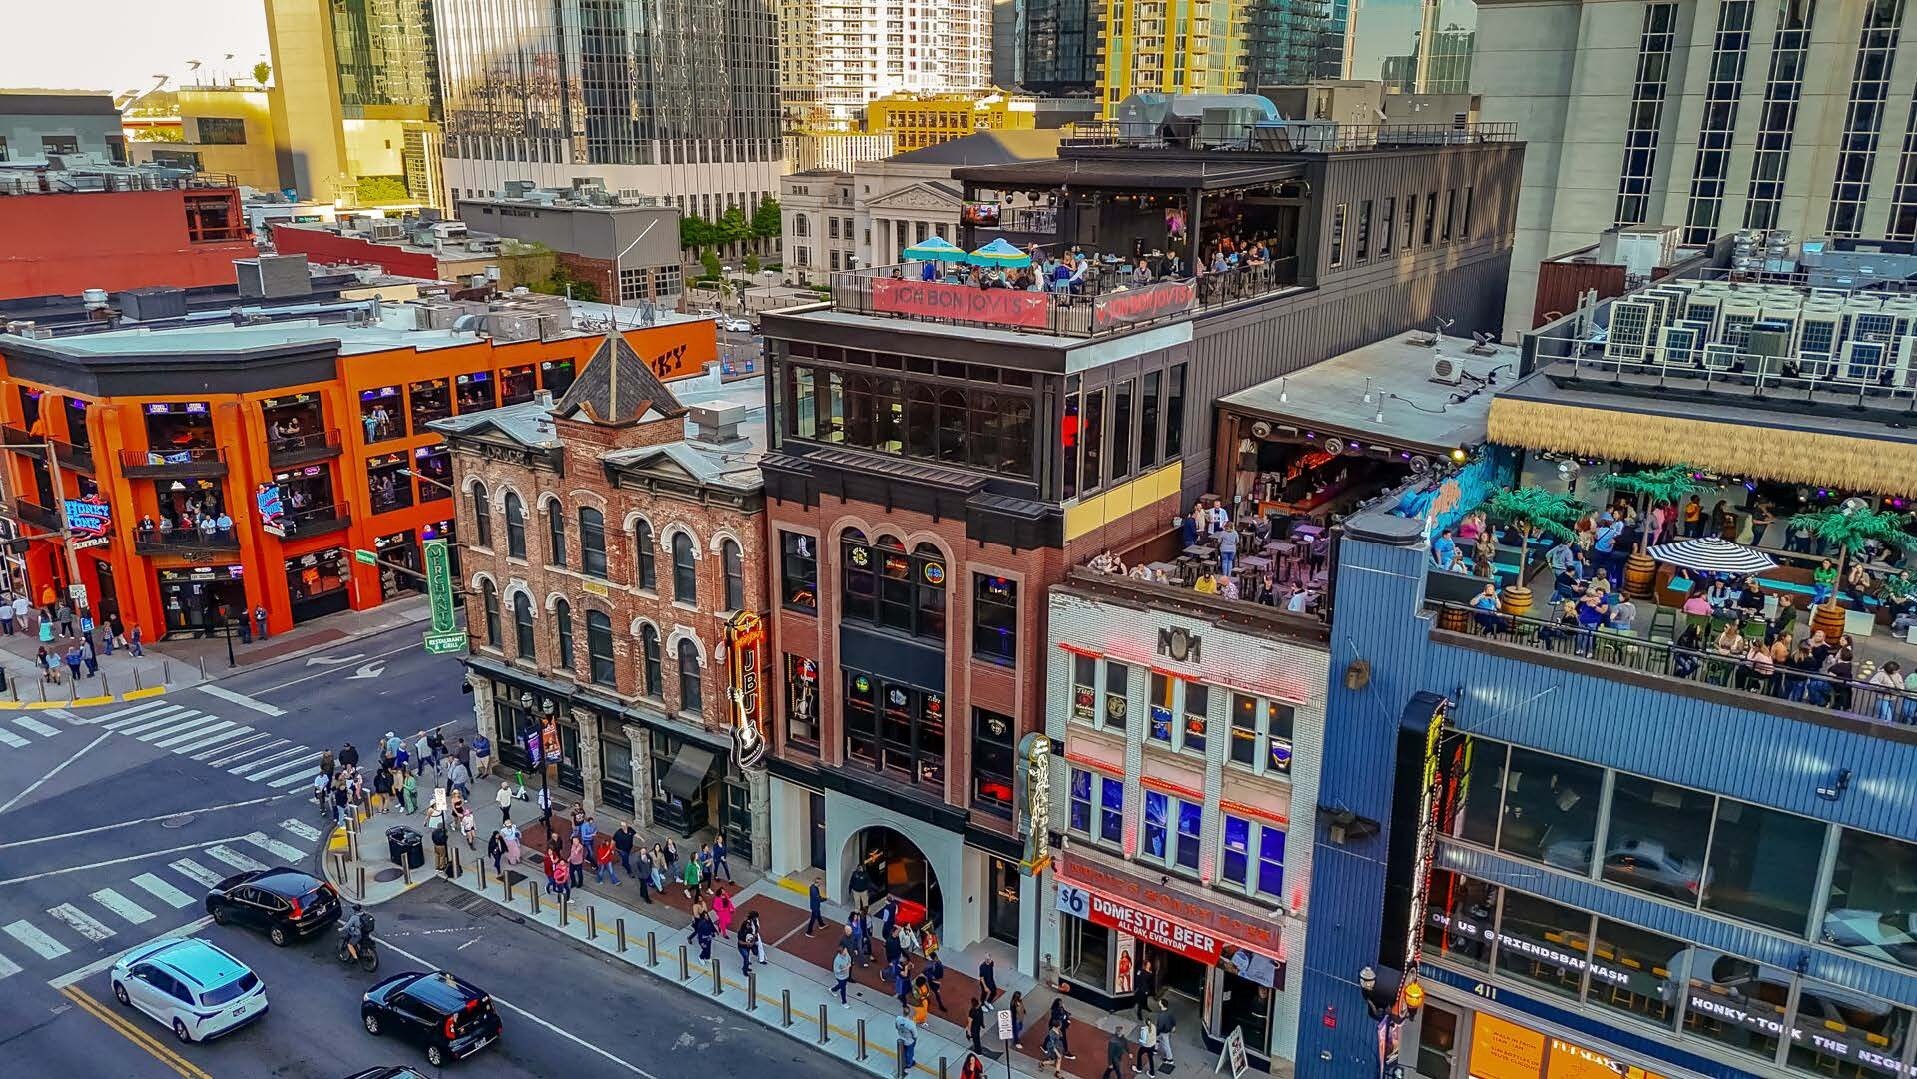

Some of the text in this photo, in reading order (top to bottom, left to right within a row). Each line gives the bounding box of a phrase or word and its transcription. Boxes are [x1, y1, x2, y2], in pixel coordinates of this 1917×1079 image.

[928, 290, 963, 308] BON
[64, 500, 109, 517] HONKY
[428, 636, 464, 646] RESTAURANT
[442, 641, 459, 650] GRILL
[1061, 888, 1084, 912] $6
[1093, 897, 1170, 939] DOMESTIC
[1173, 925, 1216, 953] BEER
[1457, 920, 1478, 933] US
[1118, 919, 1132, 933] ALL
[1149, 930, 1187, 953] EVERYDAY
[1474, 982, 1497, 1001] 411
[1813, 1034, 1849, 1055] THE
